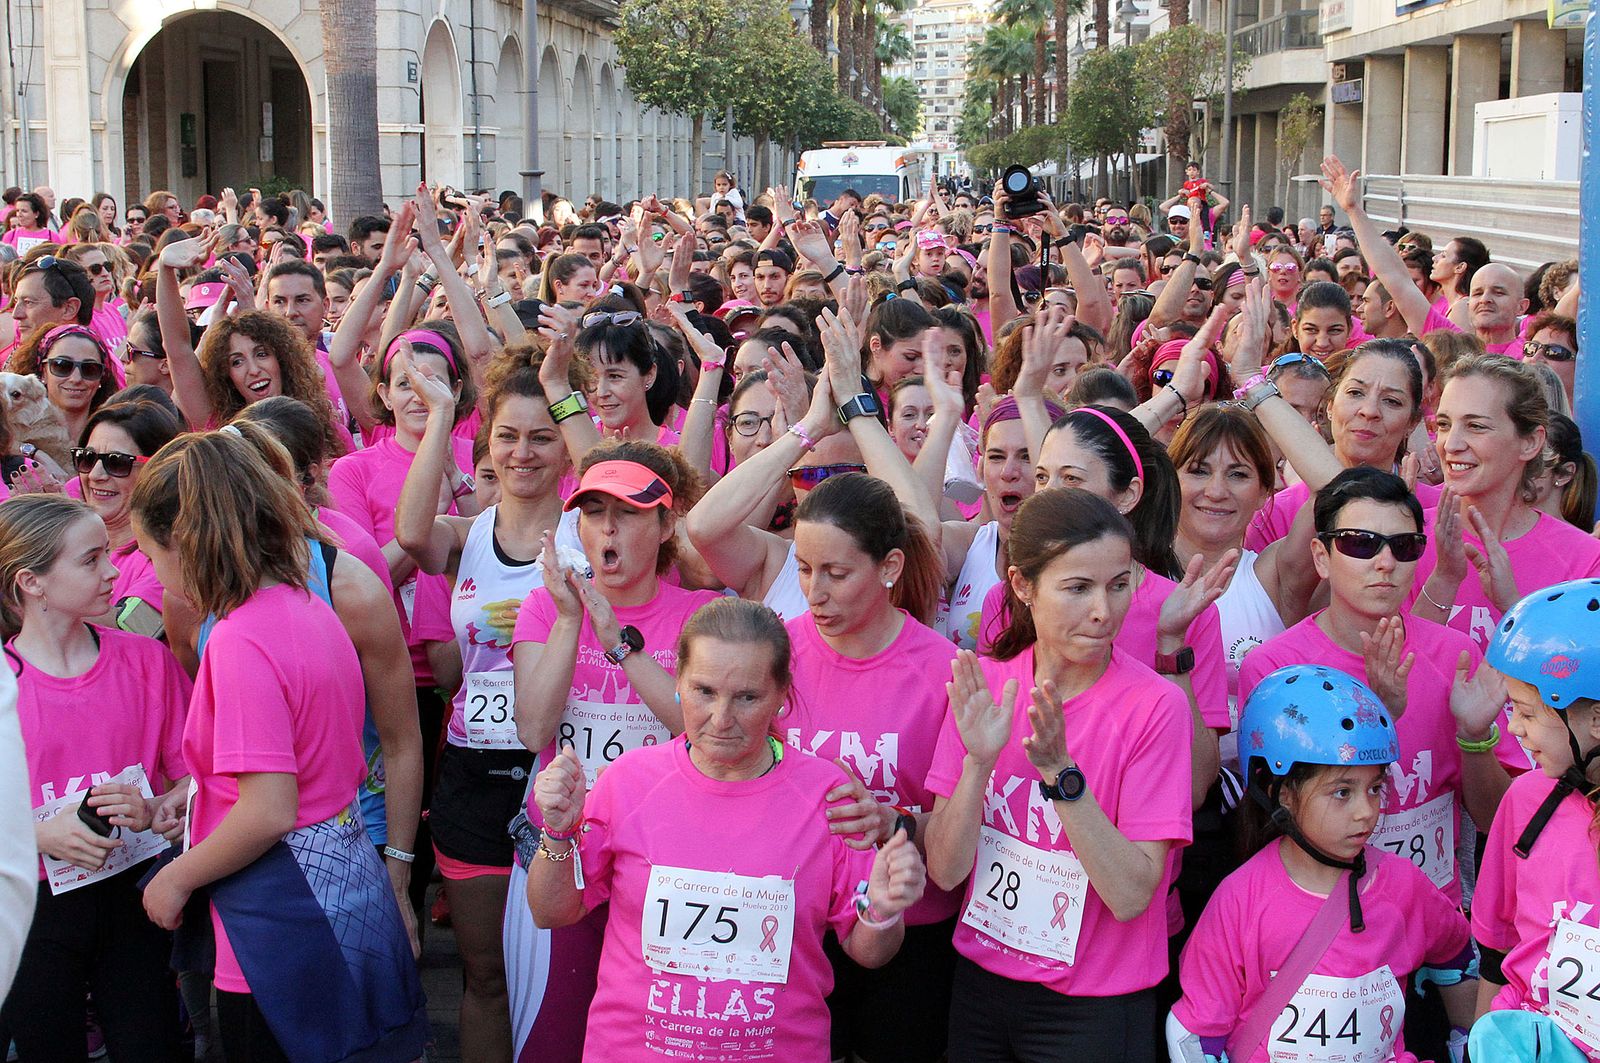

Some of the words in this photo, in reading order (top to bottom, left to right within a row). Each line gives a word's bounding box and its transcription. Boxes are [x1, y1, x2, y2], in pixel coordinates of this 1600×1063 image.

[572, 706, 607, 721] Carrera
[610, 711, 623, 722] de
[626, 712, 635, 722] la
[560, 722, 624, 762] 816
[1358, 749, 1388, 760] OXELO
[995, 841, 1021, 862] Carrera
[1022, 856, 1033, 868] de
[1036, 859, 1046, 872] la
[1049, 864, 1082, 881] Mujer
[674, 878, 719, 894] Carrera
[723, 884, 738, 897] de
[742, 886, 752, 898] la
[756, 889, 788, 903] Mujer
[986, 861, 1021, 911] 28
[1035, 875, 1060, 886] Huelva
[1061, 880, 1081, 891] 2019
[742, 901, 767, 910] Huelva
[770, 904, 788, 912] 2019
[656, 898, 739, 944] 175
[1297, 986, 1338, 999] Carrera
[1342, 988, 1357, 999] de
[1360, 986, 1369, 997] la
[1371, 978, 1393, 994] Mujer
[1361, 998, 1382, 1007] Huelva
[1382, 989, 1397, 1003] 2019
[648, 979, 775, 1023] ELLAS
[645, 1014, 655, 1025] IX
[660, 1018, 704, 1035] Carrera
[708, 1026, 724, 1037] de
[729, 1027, 740, 1037] la
[744, 1025, 776, 1037] Mujer
[1276, 1003, 1362, 1047] 244
